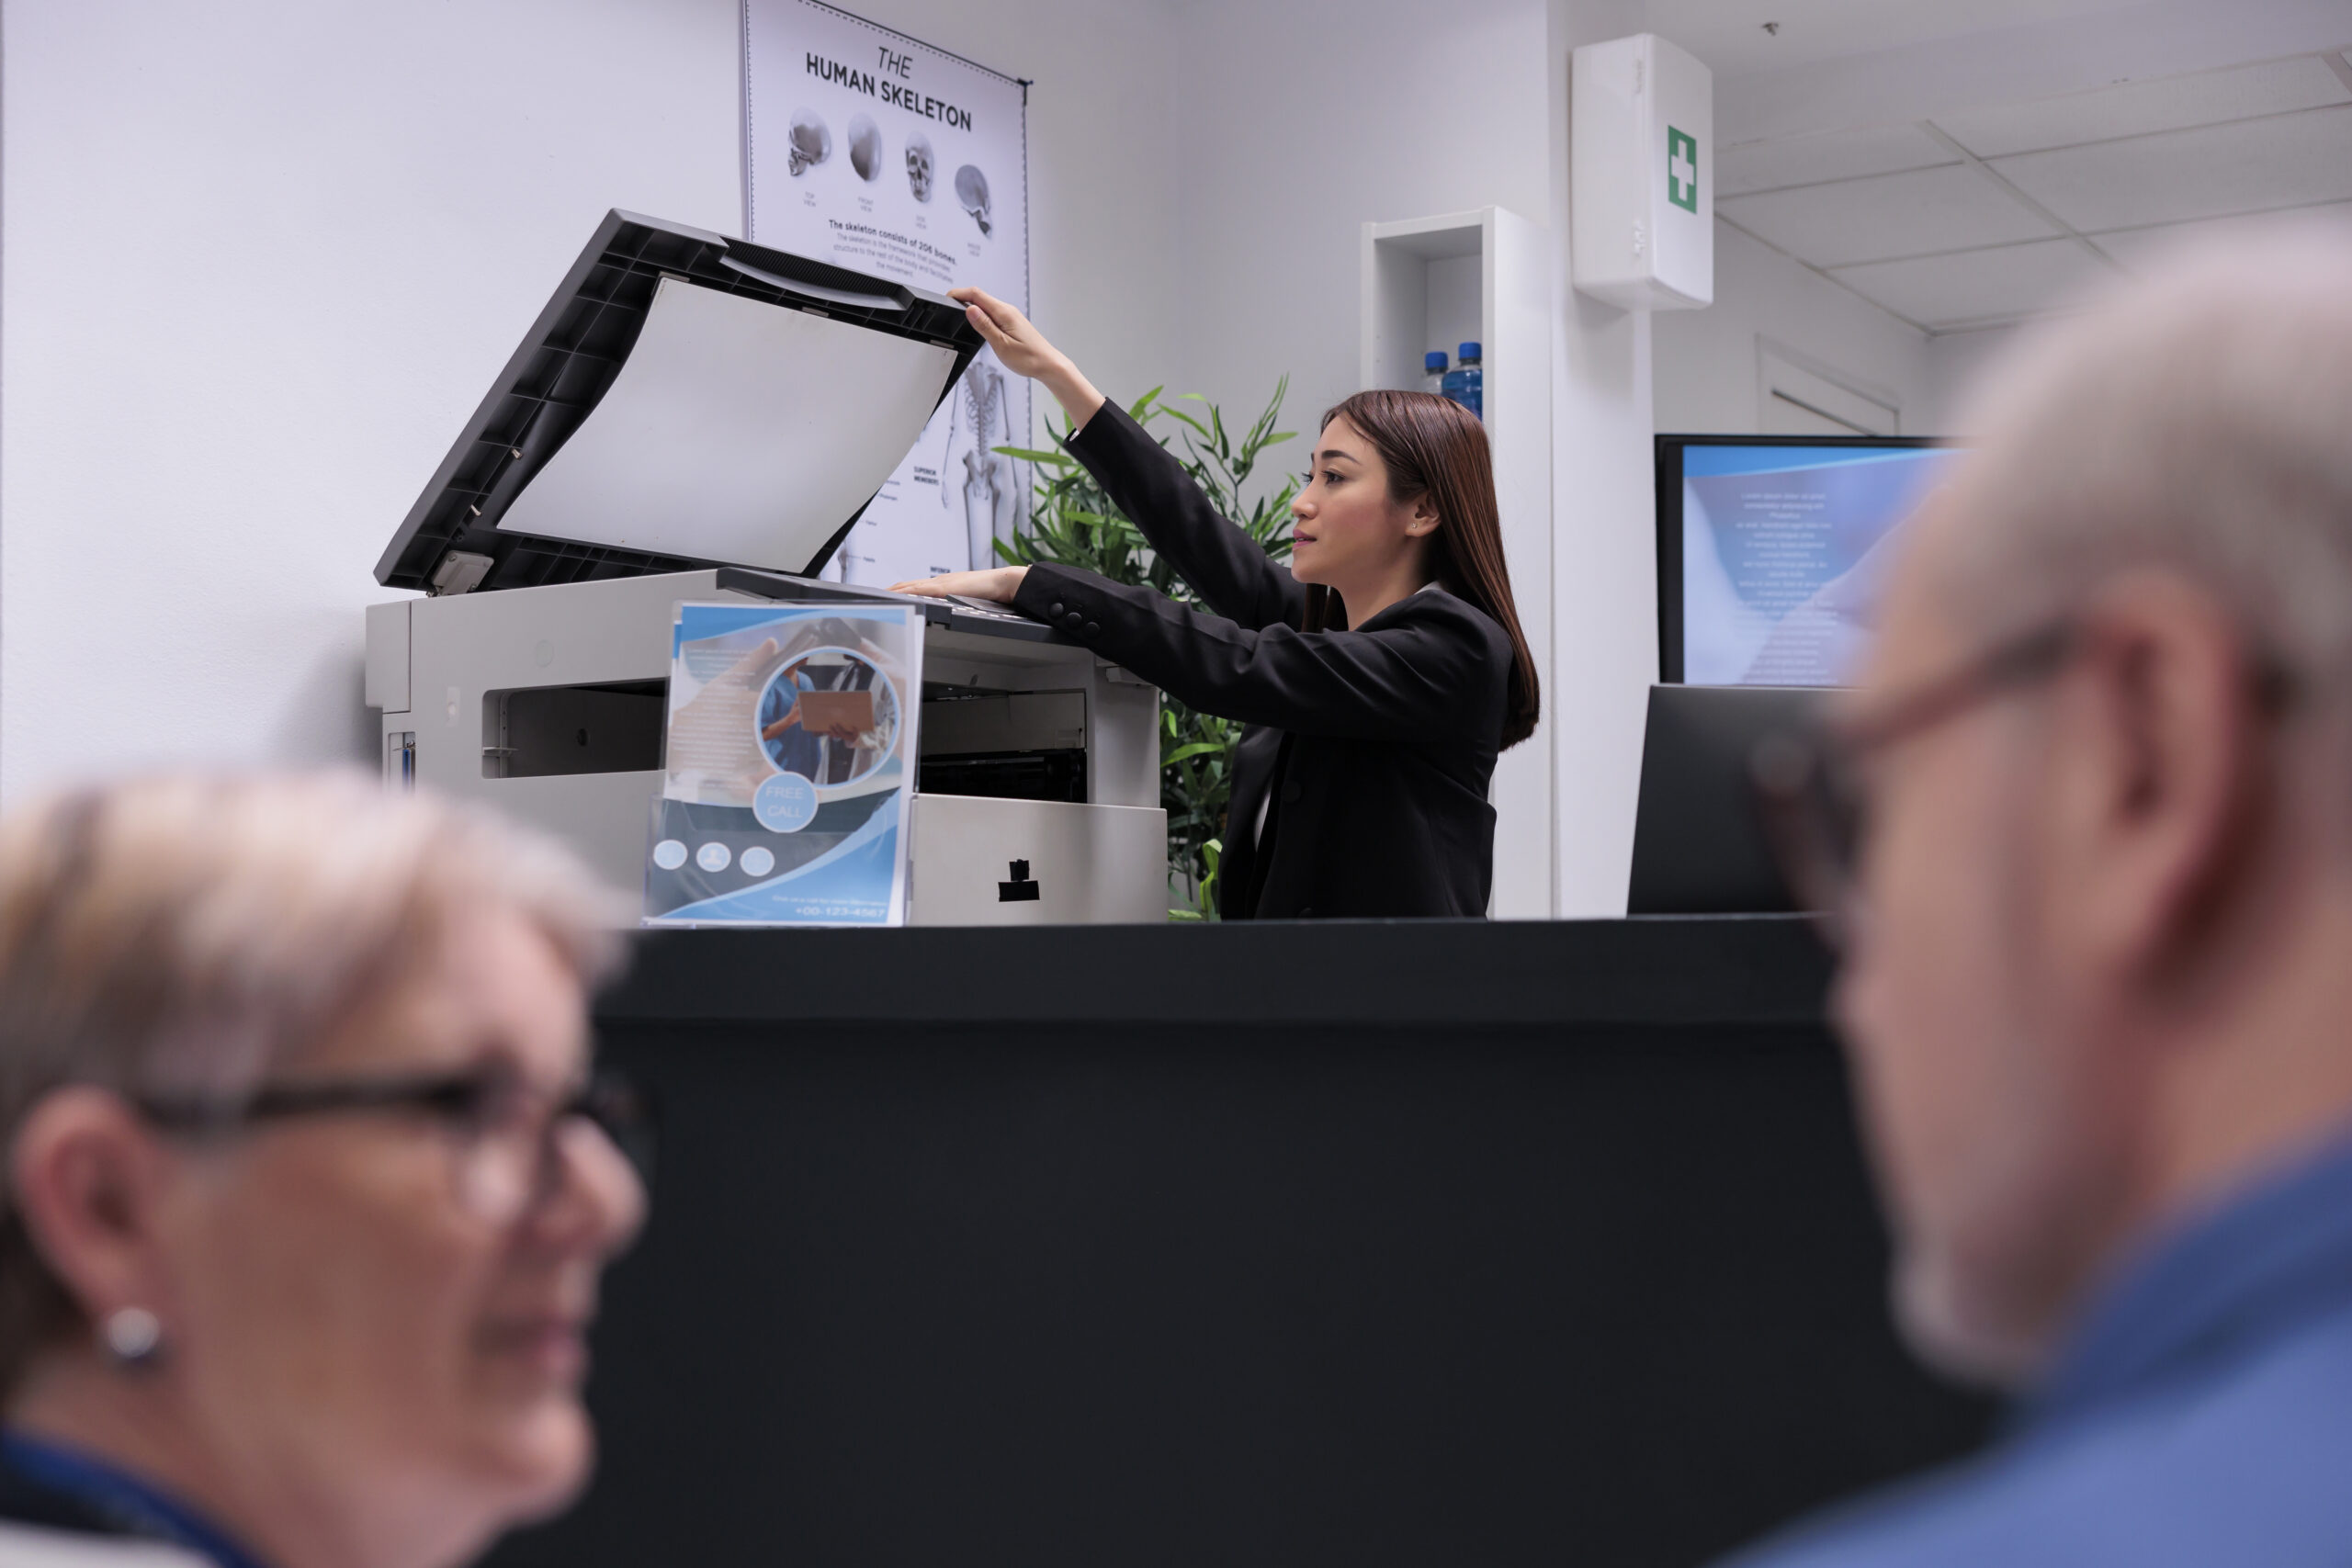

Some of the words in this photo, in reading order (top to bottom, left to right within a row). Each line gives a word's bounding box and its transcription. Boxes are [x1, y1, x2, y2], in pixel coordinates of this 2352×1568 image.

[878, 46, 913, 79] THE
[807, 51, 876, 96] HUMAN
[881, 81, 972, 132] SKELETON
[829, 219, 843, 230] The
[845, 221, 877, 236] skeleton
[878, 230, 908, 244] consists
[910, 239, 917, 247] of
[919, 241, 933, 254] 206
[934, 247, 957, 265] bones.
[765, 785, 804, 800] FREE
[766, 805, 804, 818] CALL
